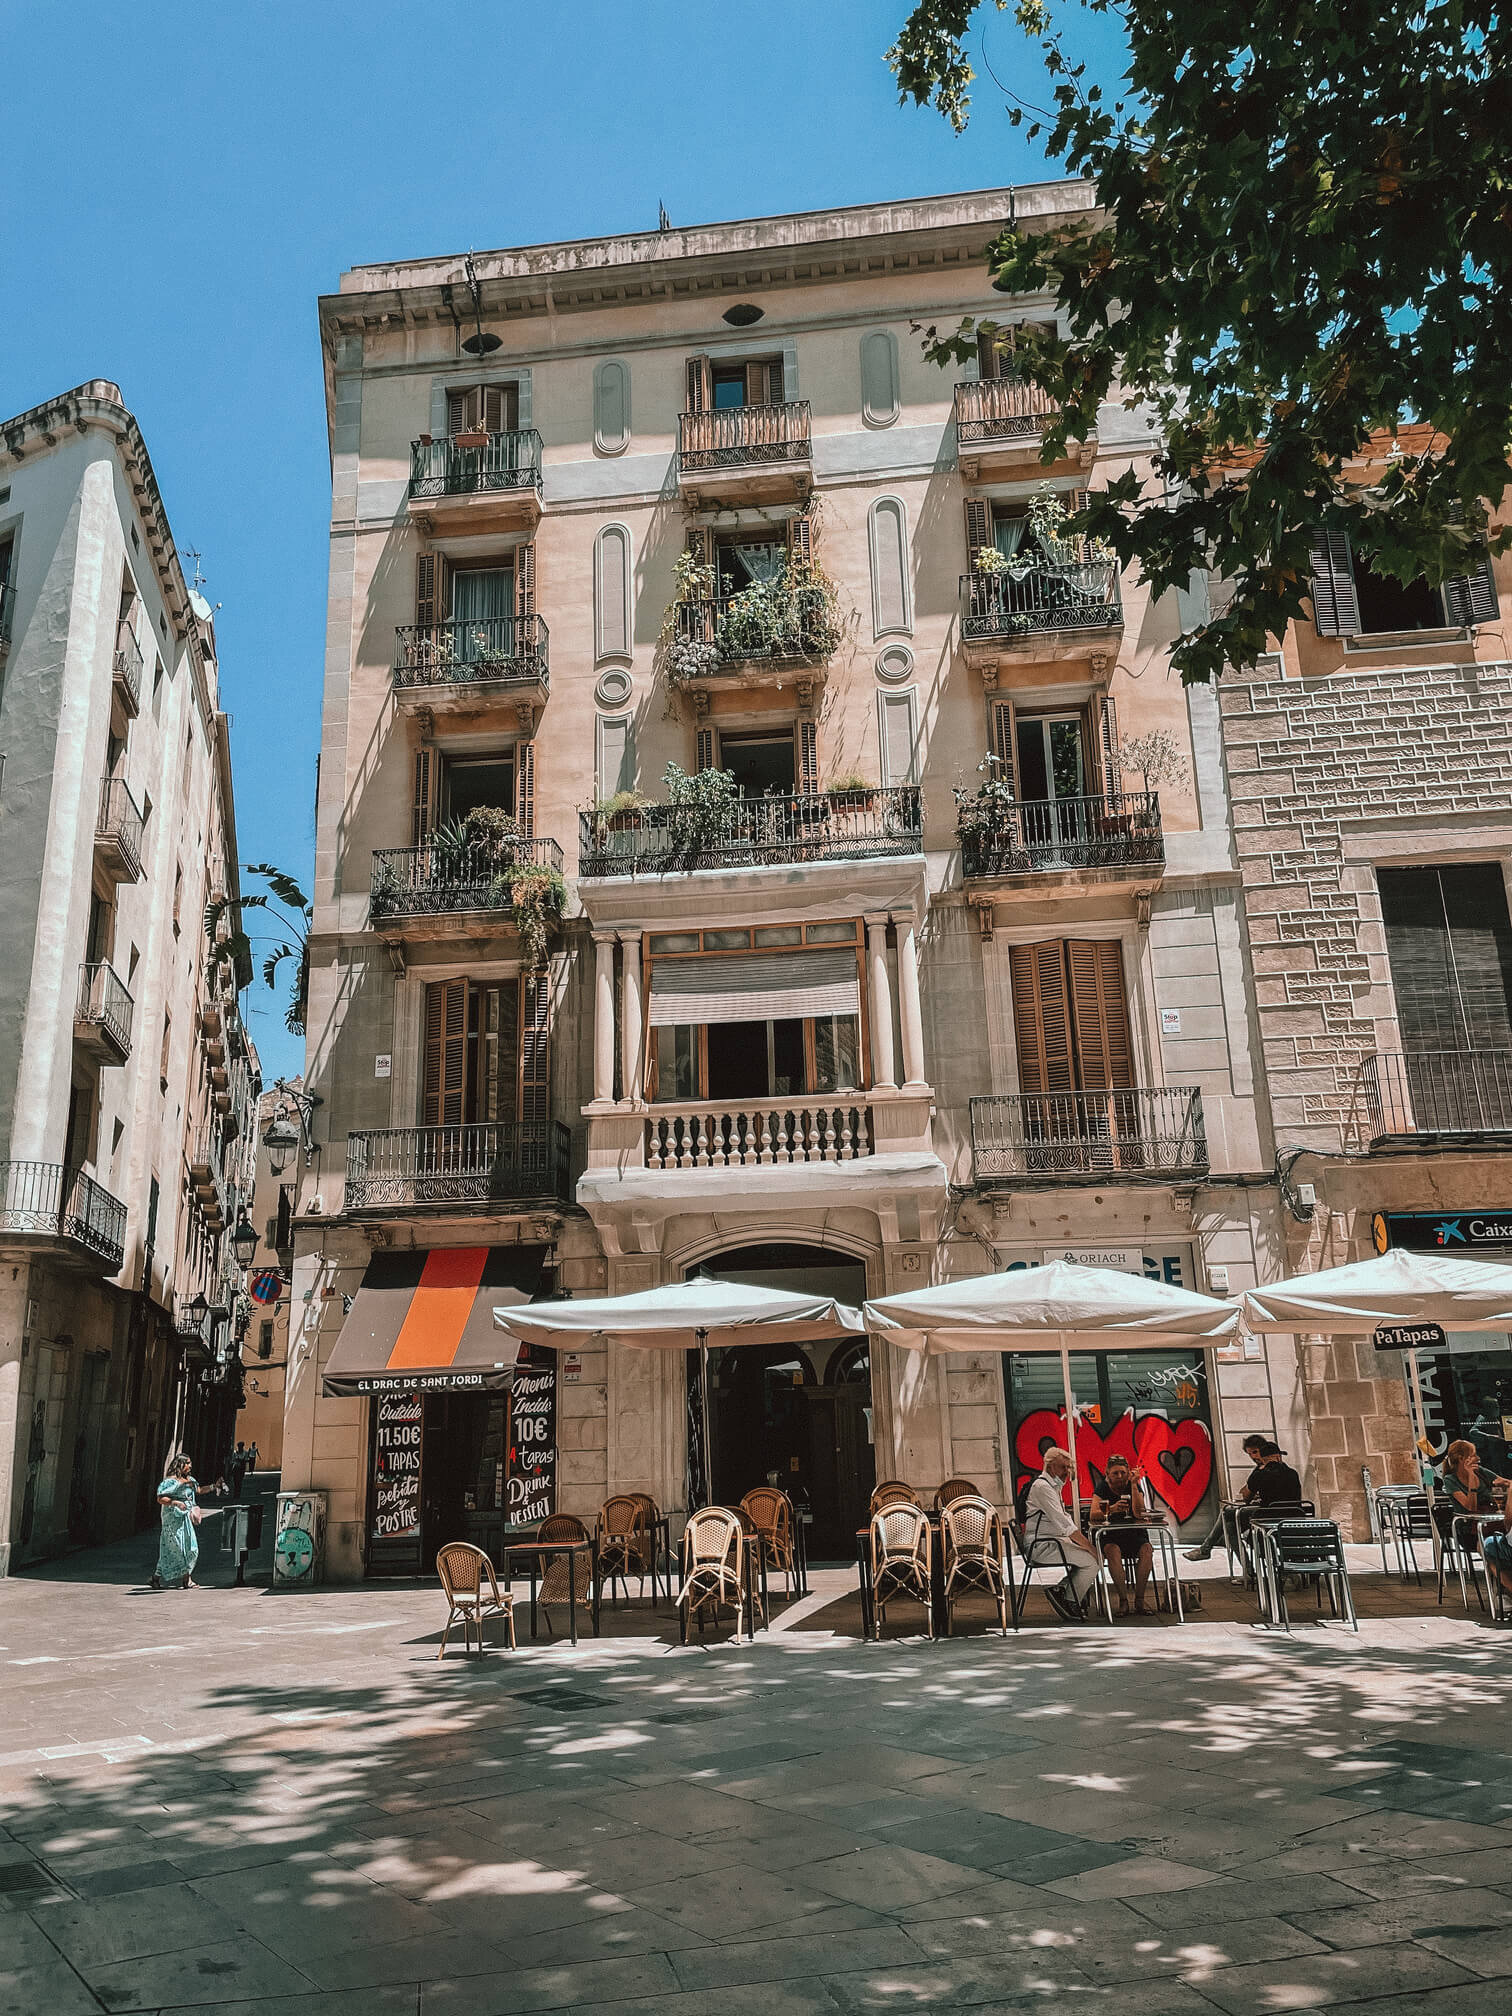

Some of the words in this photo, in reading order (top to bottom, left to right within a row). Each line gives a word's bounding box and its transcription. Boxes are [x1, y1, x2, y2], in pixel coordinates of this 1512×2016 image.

[1375, 1329, 1440, 1345] PaTapas
[358, 1381, 370, 1390] EL
[372, 1380, 400, 1389] DRAC
[403, 1379, 418, 1388] DE
[420, 1377, 448, 1387] SANT
[450, 1375, 483, 1386] JORDI
[379, 1403, 422, 1421] Outside
[512, 1397, 552, 1415] Inside
[378, 1426, 421, 1447] 11.50€
[515, 1417, 548, 1442] 10€
[378, 1452, 384, 1470] 4
[387, 1450, 420, 1471] TAPAS
[509, 1447, 516, 1463] 4
[377, 1475, 418, 1509] Bebida
[376, 1506, 418, 1534] POSTRE
[510, 1496, 550, 1526] DESSERT
